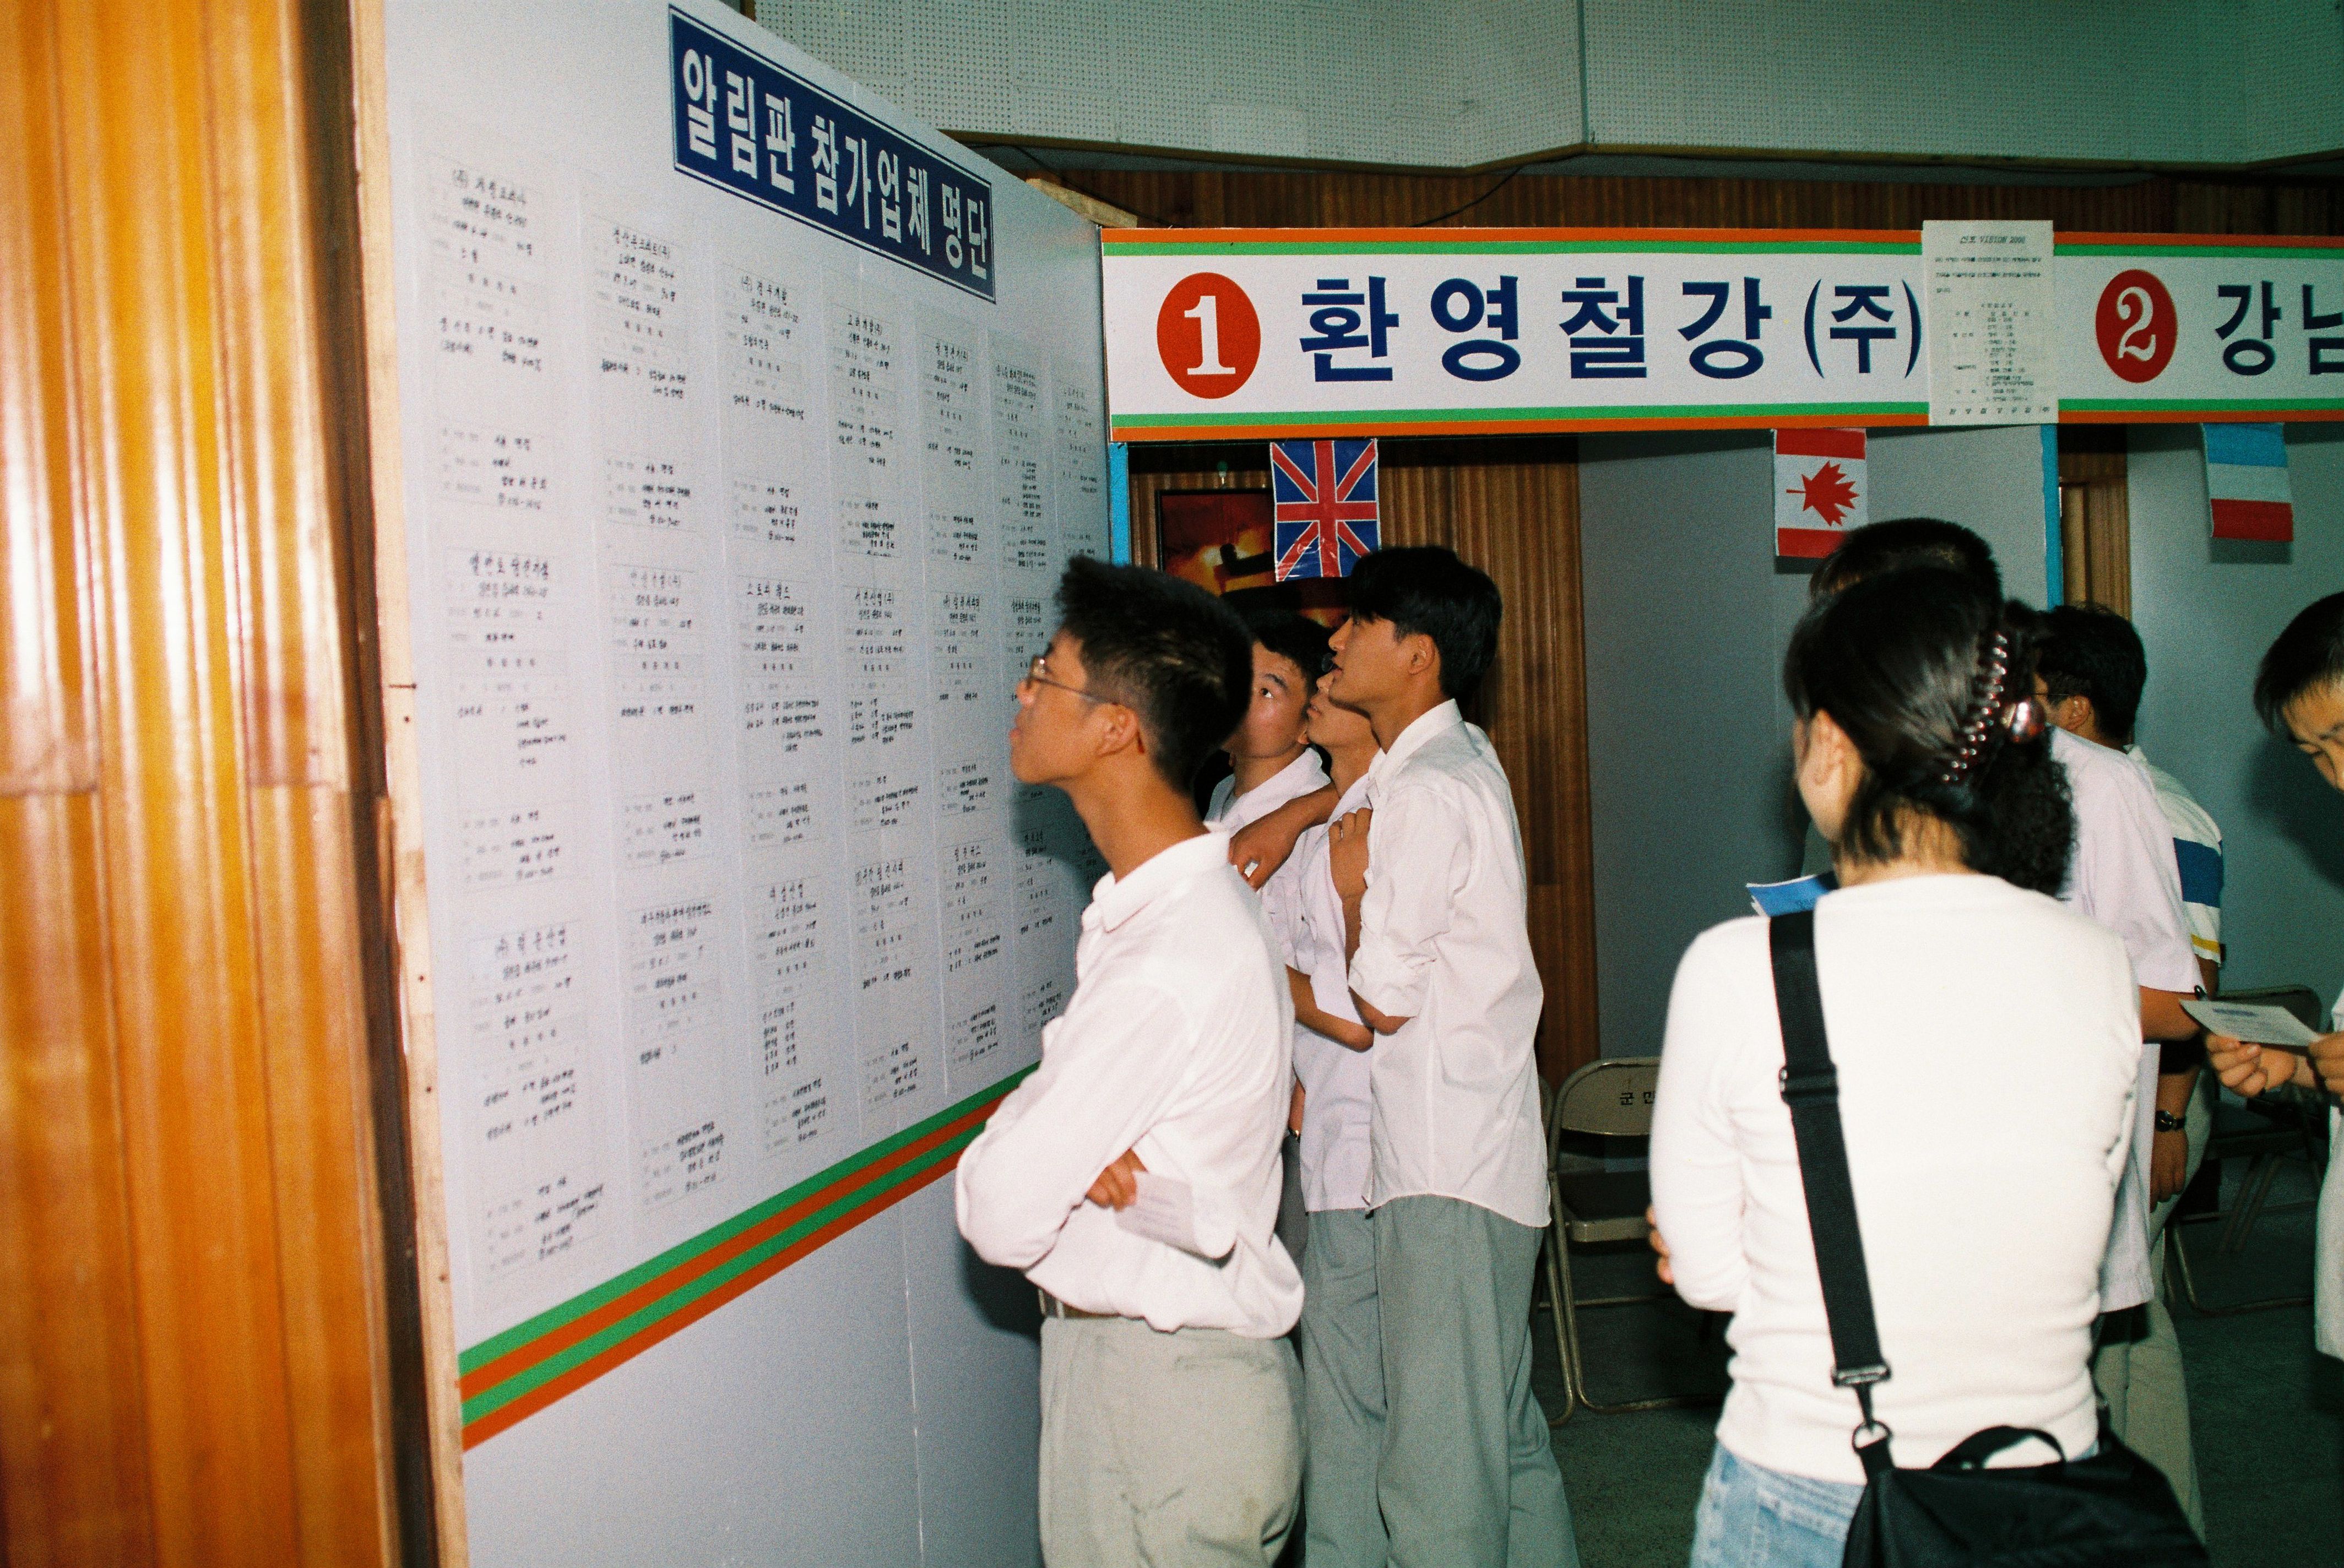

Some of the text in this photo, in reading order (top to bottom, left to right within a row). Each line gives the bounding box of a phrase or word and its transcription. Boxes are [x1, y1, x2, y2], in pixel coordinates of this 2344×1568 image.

[682, 47, 987, 280] 알림판 참가업체 명단
[1979, 235, 2007, 245] VISION
[2009, 235, 2027, 245] 2000
[1184, 295, 1235, 375] 1
[2116, 286, 2157, 361] 2
